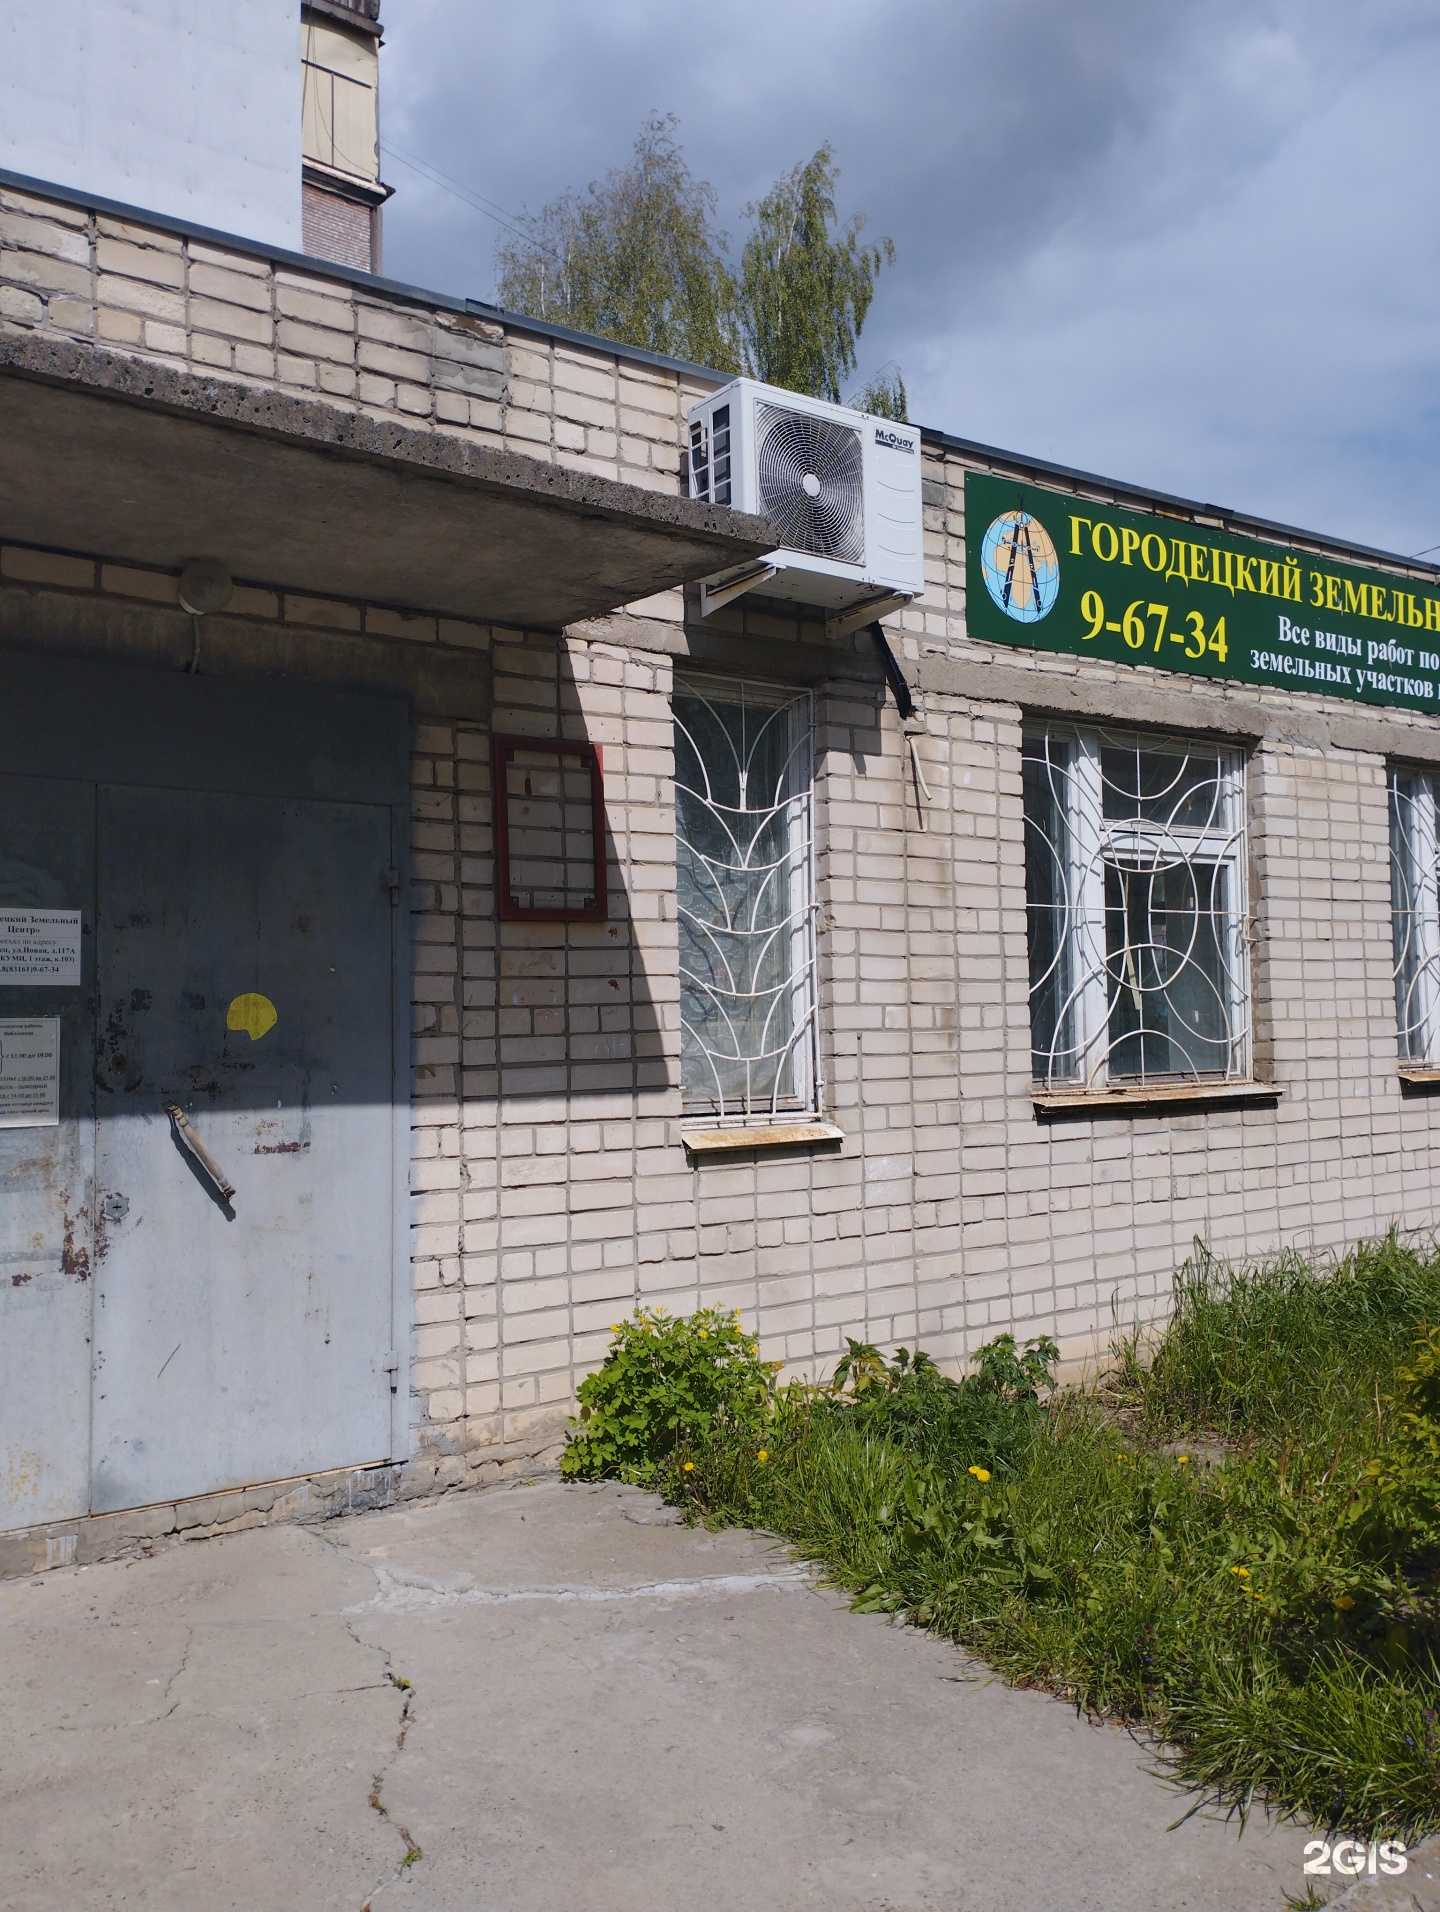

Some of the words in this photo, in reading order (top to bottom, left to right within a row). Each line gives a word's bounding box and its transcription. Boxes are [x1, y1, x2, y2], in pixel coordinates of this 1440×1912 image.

[875, 429, 914, 449] McQuay
[1067, 514, 1303, 603] ГОРОДЕЦКИЙ
[1309, 570, 1440, 632] ЗЕМЕЛЬН
[1080, 590, 1229, 664] 9-67-34
[1278, 615, 1311, 646] Все
[1314, 629, 1363, 657] виды
[1367, 638, 1415, 666] работ
[1249, 648, 1352, 685] земельных
[1355, 668, 1434, 698] участков
